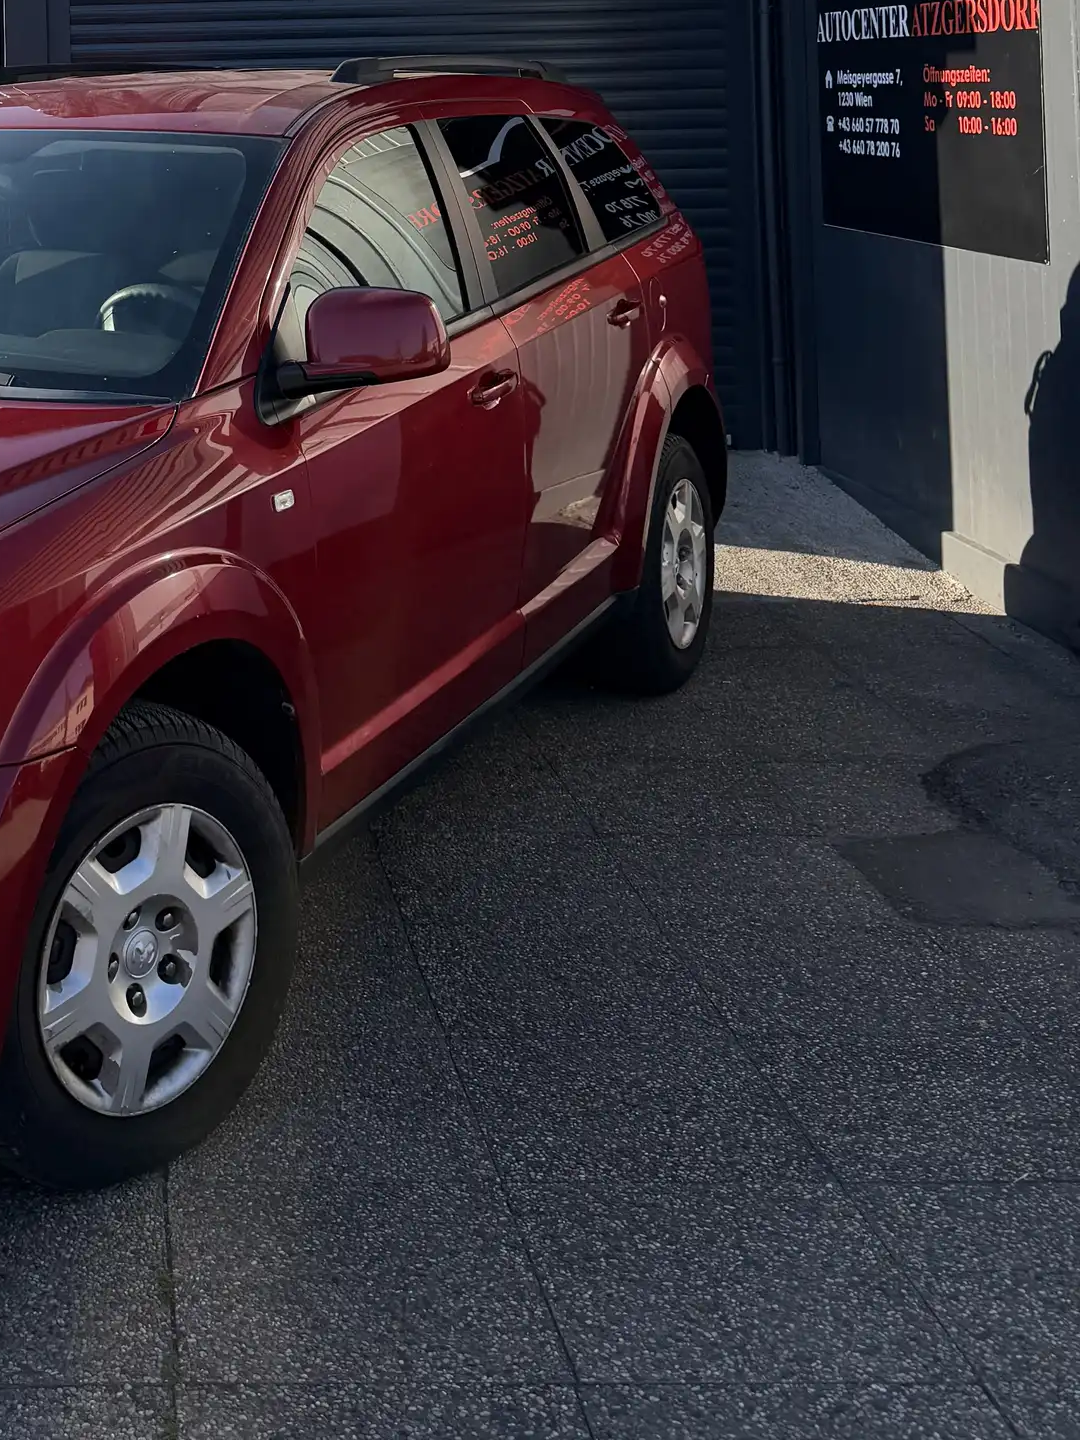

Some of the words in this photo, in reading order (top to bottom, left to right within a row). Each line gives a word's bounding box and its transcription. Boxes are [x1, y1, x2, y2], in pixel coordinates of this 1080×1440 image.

[817, 4, 909, 42] AUTOCENTER
[837, 69, 894, 88] Meisgeyergasse
[895, 68, 903, 86] 7,
[923, 63, 991, 86] Öffnungszeiten:
[838, 92, 854, 107] 1230
[855, 92, 873, 107] Wien
[924, 92, 937, 107] Mo
[945, 91, 953, 108] Fr
[956, 91, 981, 108] 09:00
[990, 91, 1016, 109] 18:00
[838, 116, 851, 132] +43
[851, 117, 864, 132] 660
[865, 118, 874, 133] 57
[875, 118, 889, 134] 778
[890, 119, 900, 135] 70
[924, 115, 935, 131] Sa
[958, 116, 982, 134] 10:00
[991, 117, 1017, 136] 16:00
[838, 139, 851, 154] +43
[852, 140, 865, 155] 660
[866, 140, 875, 156] 78
[876, 141, 890, 157] 200
[891, 142, 901, 158] 76
